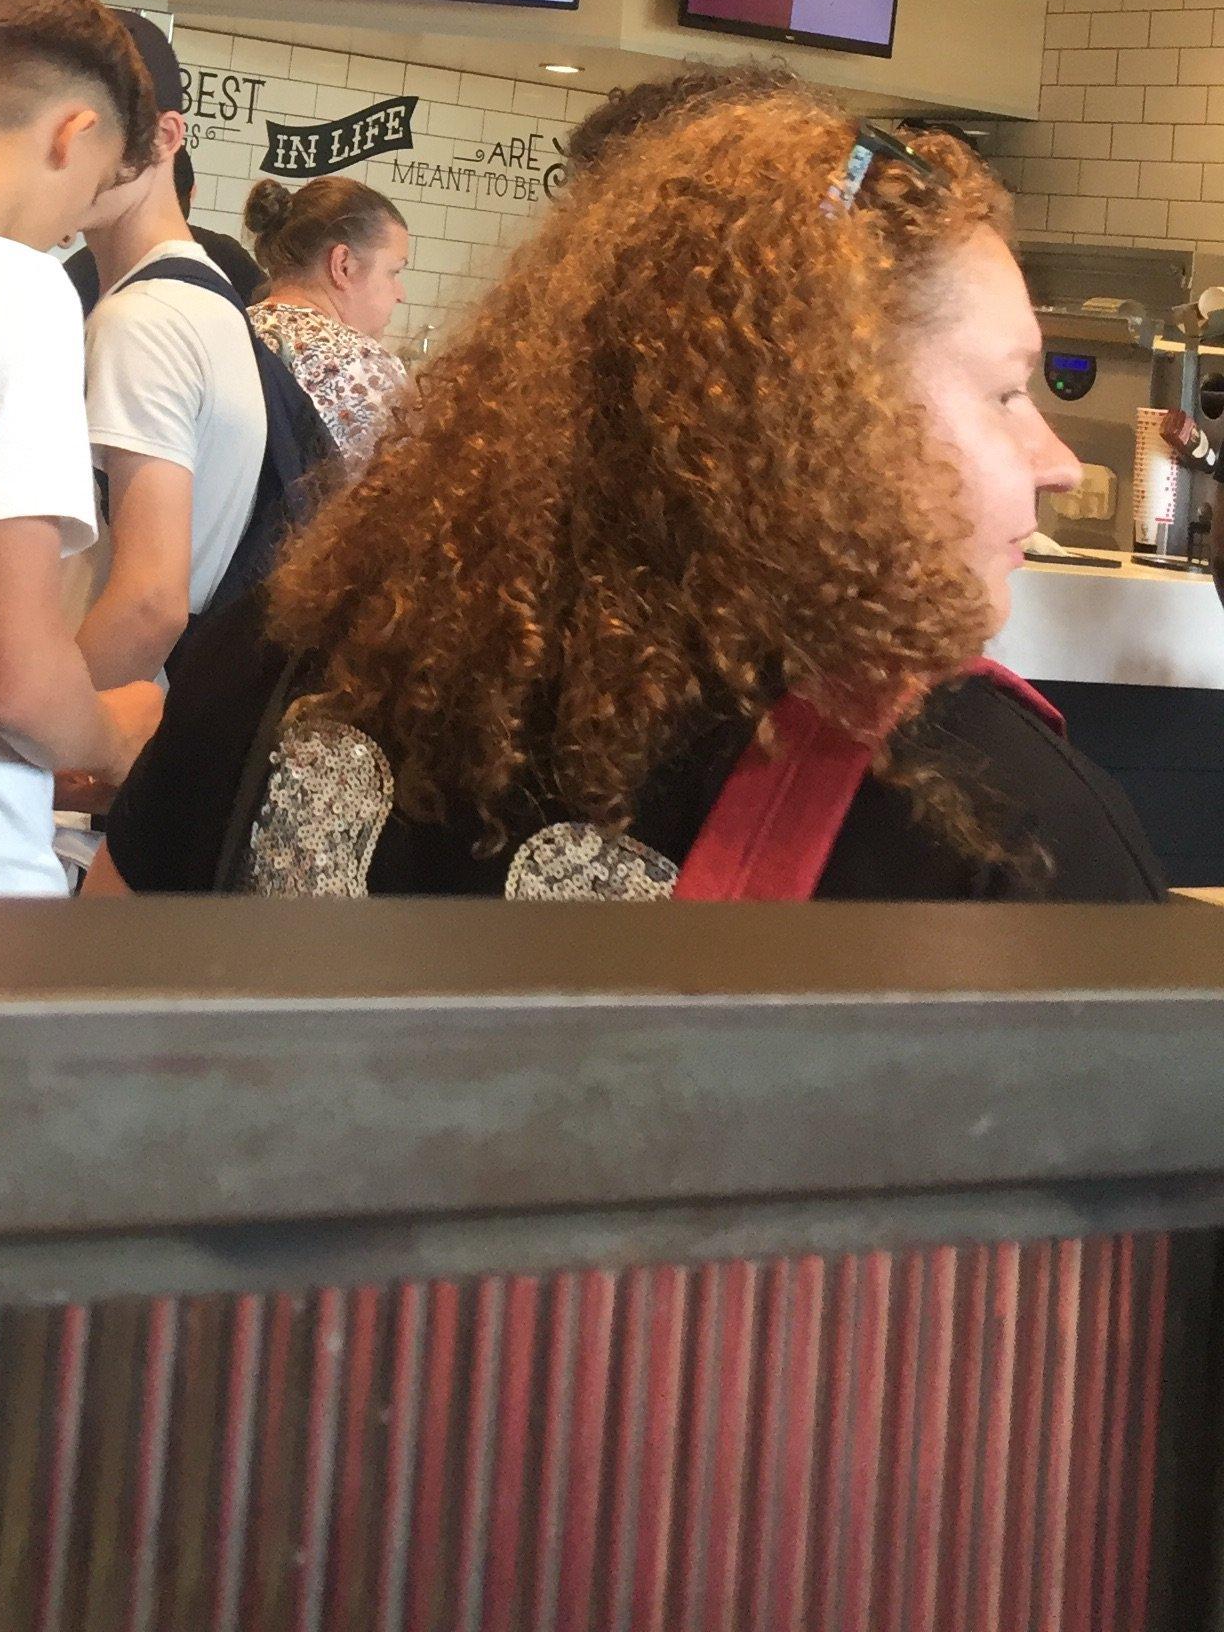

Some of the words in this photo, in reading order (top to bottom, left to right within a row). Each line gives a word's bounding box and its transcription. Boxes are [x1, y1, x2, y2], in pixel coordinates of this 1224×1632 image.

[178, 68, 266, 124] BEST
[273, 132, 320, 170] IN
[328, 105, 406, 165] LIFE
[487, 133, 544, 171] ARE
[391, 159, 476, 193] MEANT
[484, 171, 509, 198] TO
[513, 176, 541, 202] BE
